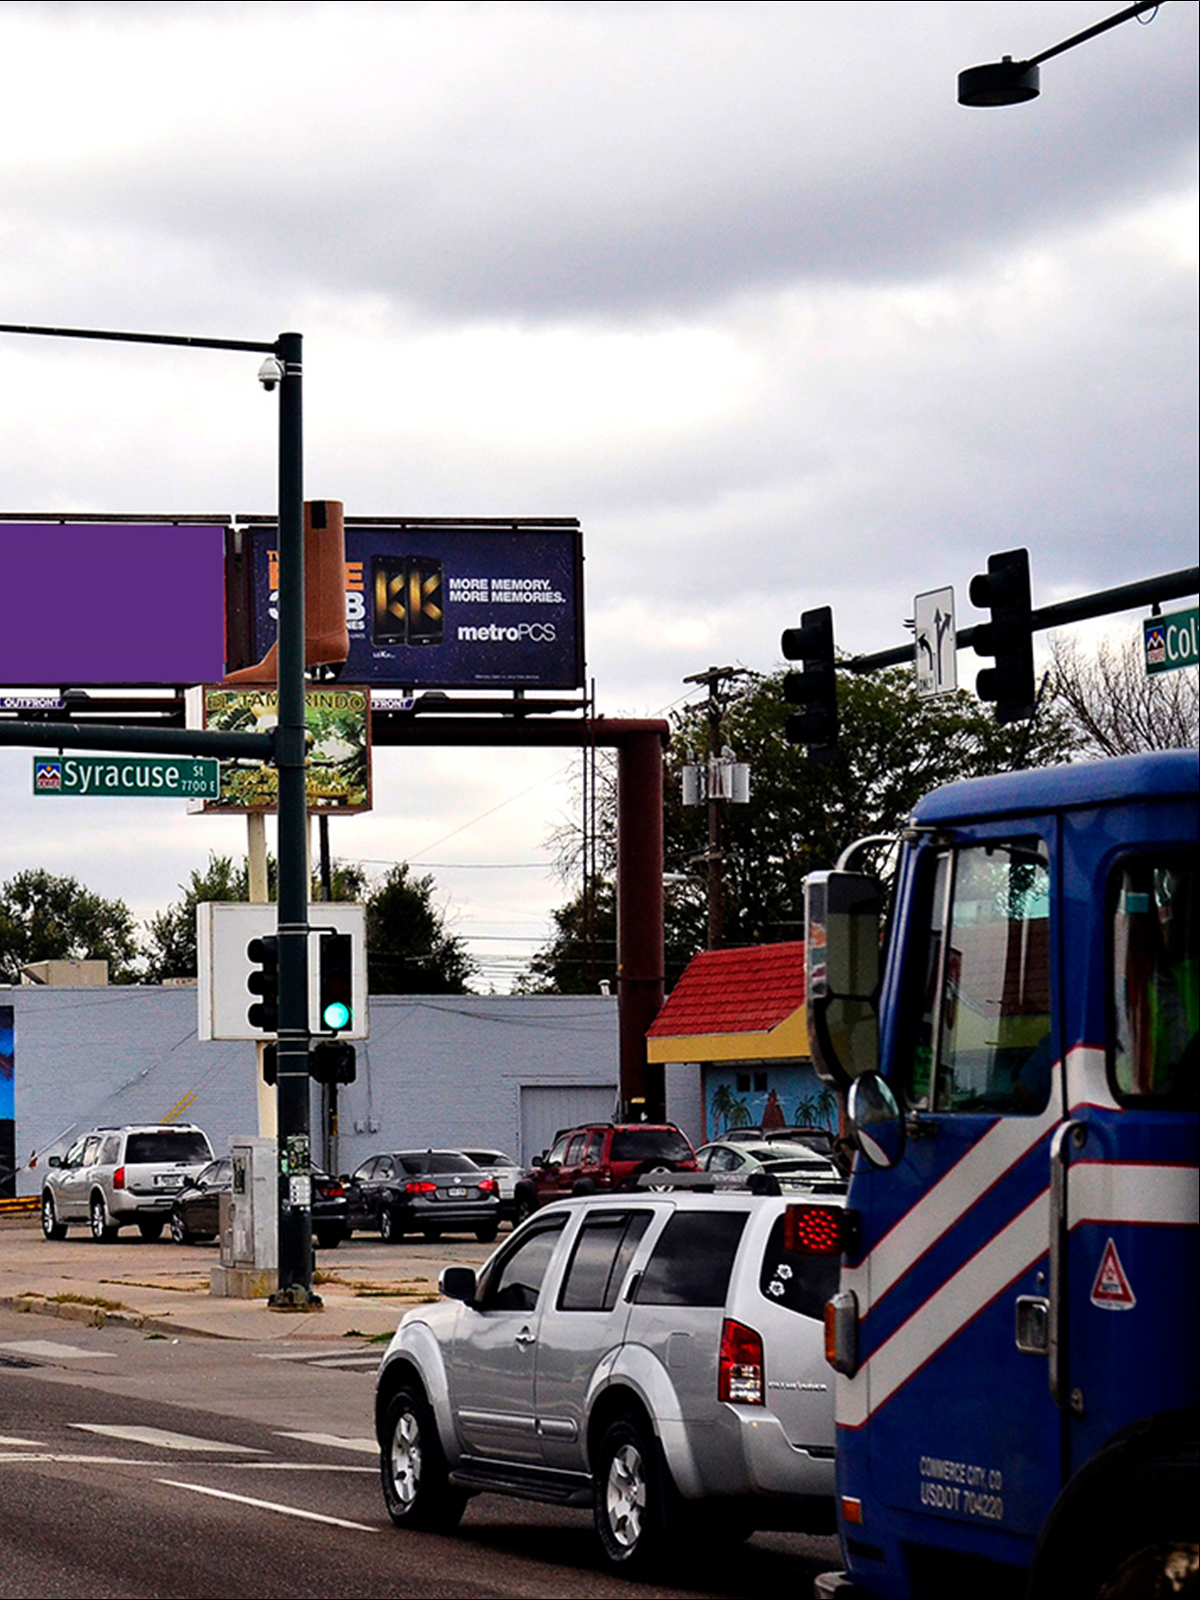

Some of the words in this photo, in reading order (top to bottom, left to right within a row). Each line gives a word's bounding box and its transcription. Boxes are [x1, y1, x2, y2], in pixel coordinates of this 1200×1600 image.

[448, 578, 489, 590] MORE
[491, 578, 552, 591] MEMORY.
[448, 590, 489, 603] MORE
[491, 591, 566, 604] MEMORIES.
[457, 622, 557, 642] metroPCS
[1167, 617, 1199, 661] Col
[240, 692, 367, 712] TAMRINDO
[373, 698, 407, 710] FRONT
[64, 760, 180, 793] Syracuse
[193, 764, 204, 777] St
[181, 779, 207, 792] 7700
[209, 780, 216, 792] E
[920, 1482, 960, 1511] USDOT
